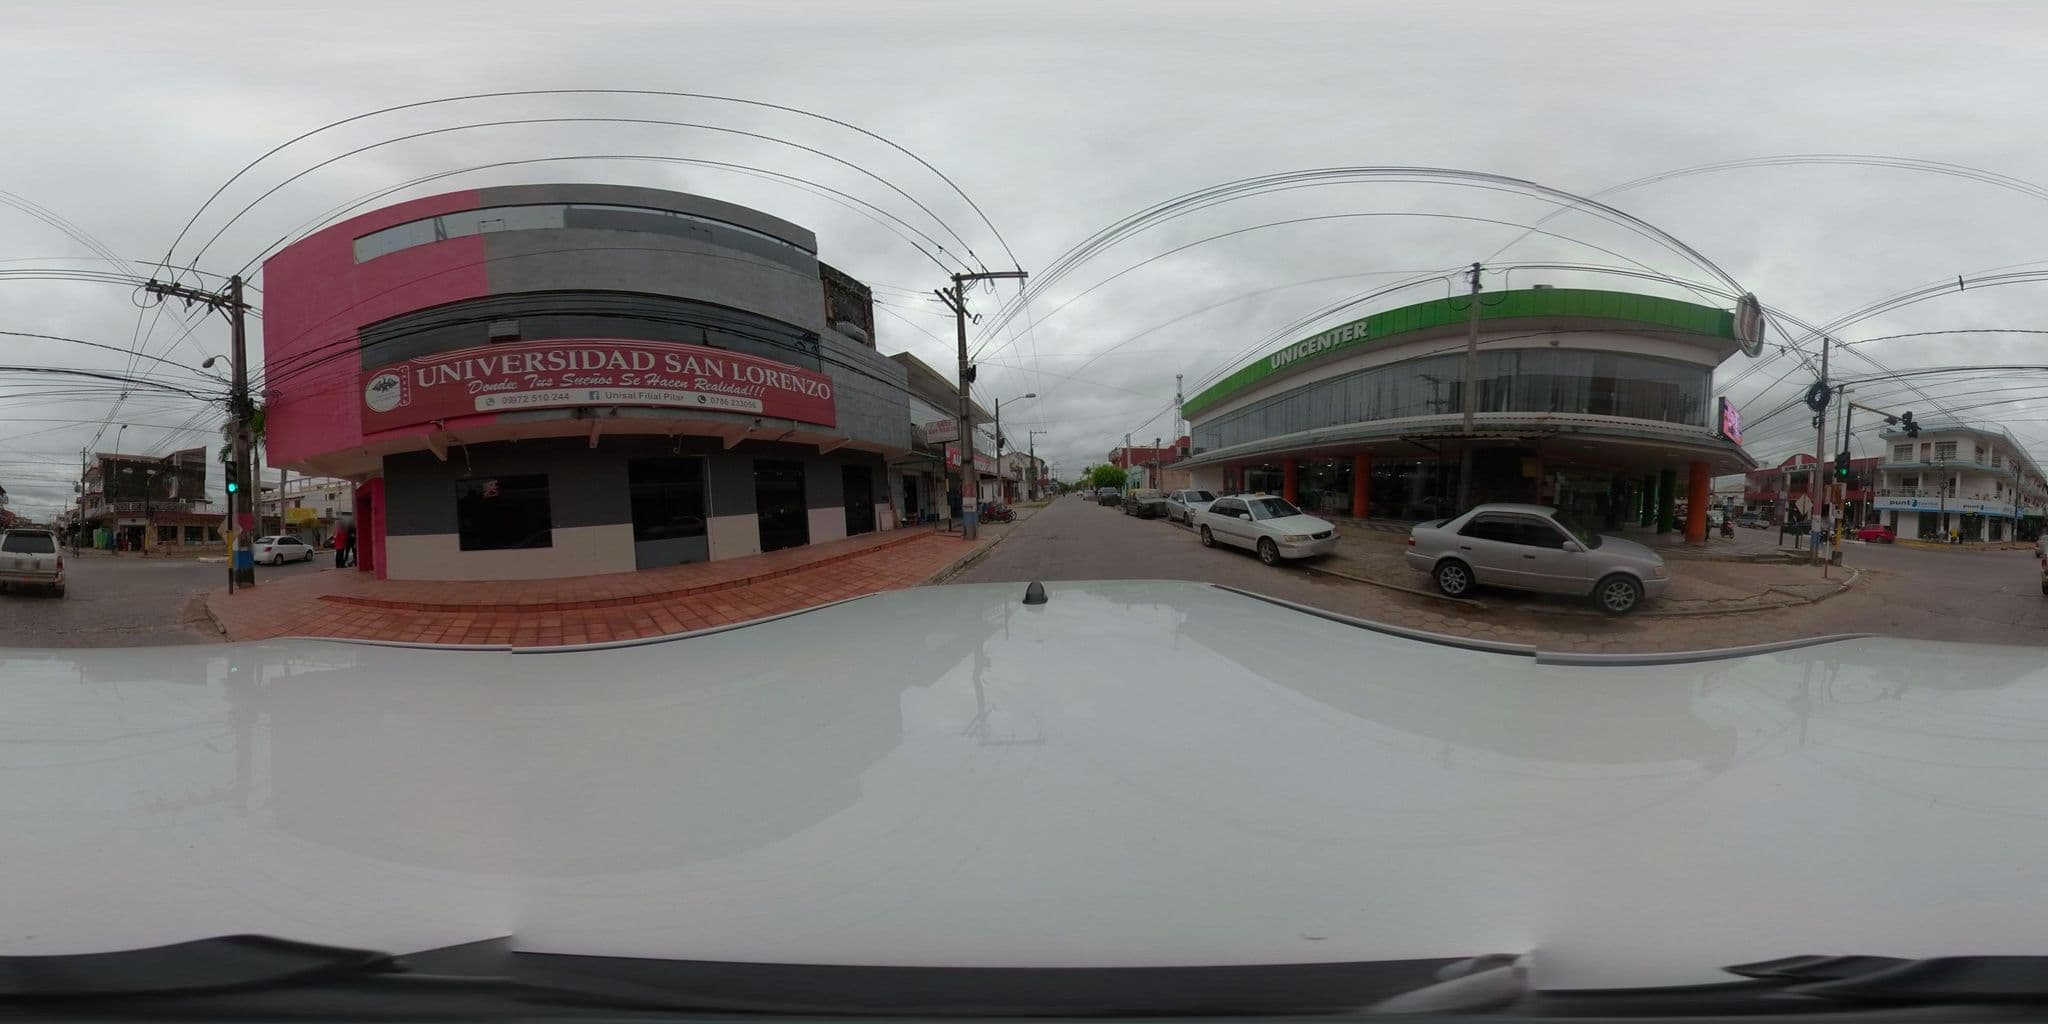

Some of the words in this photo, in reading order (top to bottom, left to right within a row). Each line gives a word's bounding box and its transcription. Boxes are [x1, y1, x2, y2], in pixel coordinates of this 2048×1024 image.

[1270, 321, 1368, 369] UNICENTER
[416, 349, 656, 388] UNIVERSIDAD
[664, 353, 724, 378] SAN
[731, 362, 831, 400] LORENZO
[523, 374, 553, 389] Tus
[560, 373, 613, 387] Sueños
[619, 373, 641, 386] Se
[646, 374, 688, 388] Hacen
[693, 377, 766, 397] Realidad!!!
[531, 393, 549, 403] 510
[552, 392, 569, 401] 244
[605, 391, 636, 400] Unisal
[639, 391, 661, 401] Filial
[664, 392, 684, 401] Pilar
